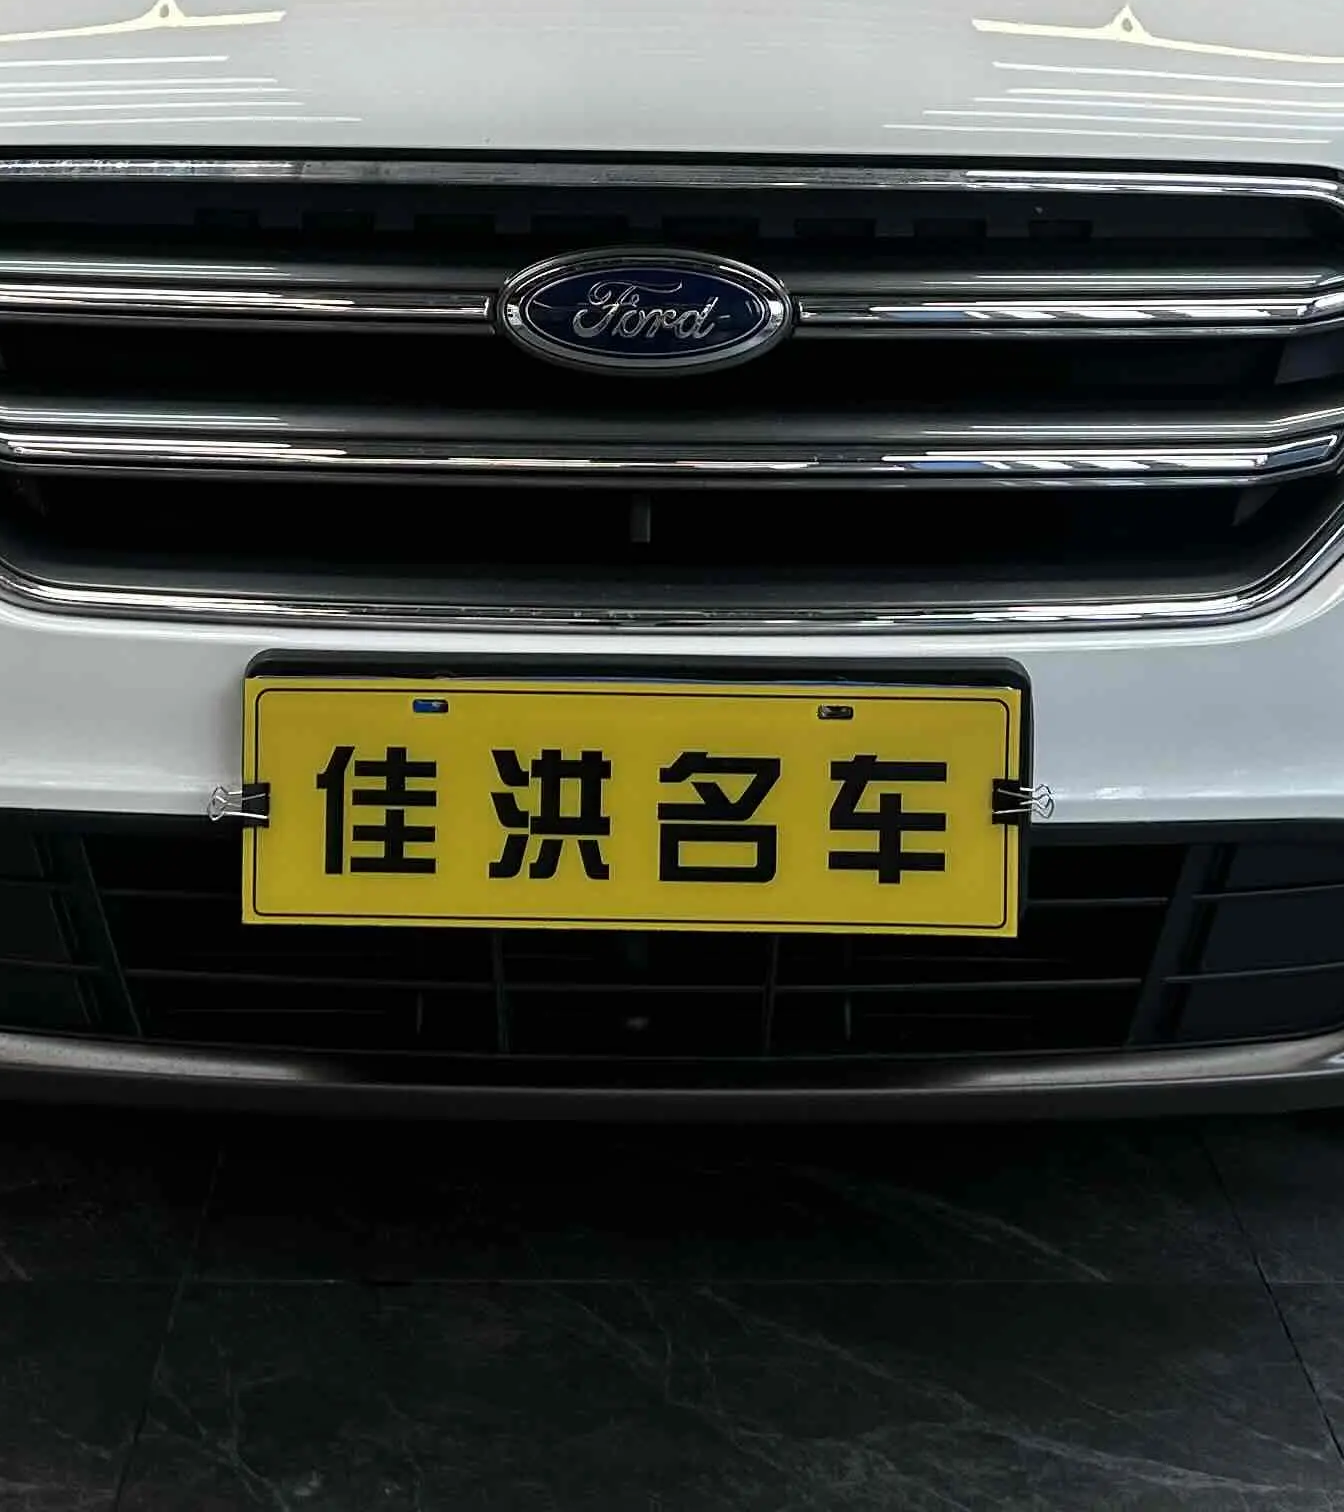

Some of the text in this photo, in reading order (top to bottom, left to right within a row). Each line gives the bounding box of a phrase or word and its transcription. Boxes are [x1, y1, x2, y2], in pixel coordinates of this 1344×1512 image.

[573, 280, 719, 339] Ford
[316, 745, 948, 885] 佳洪名车
